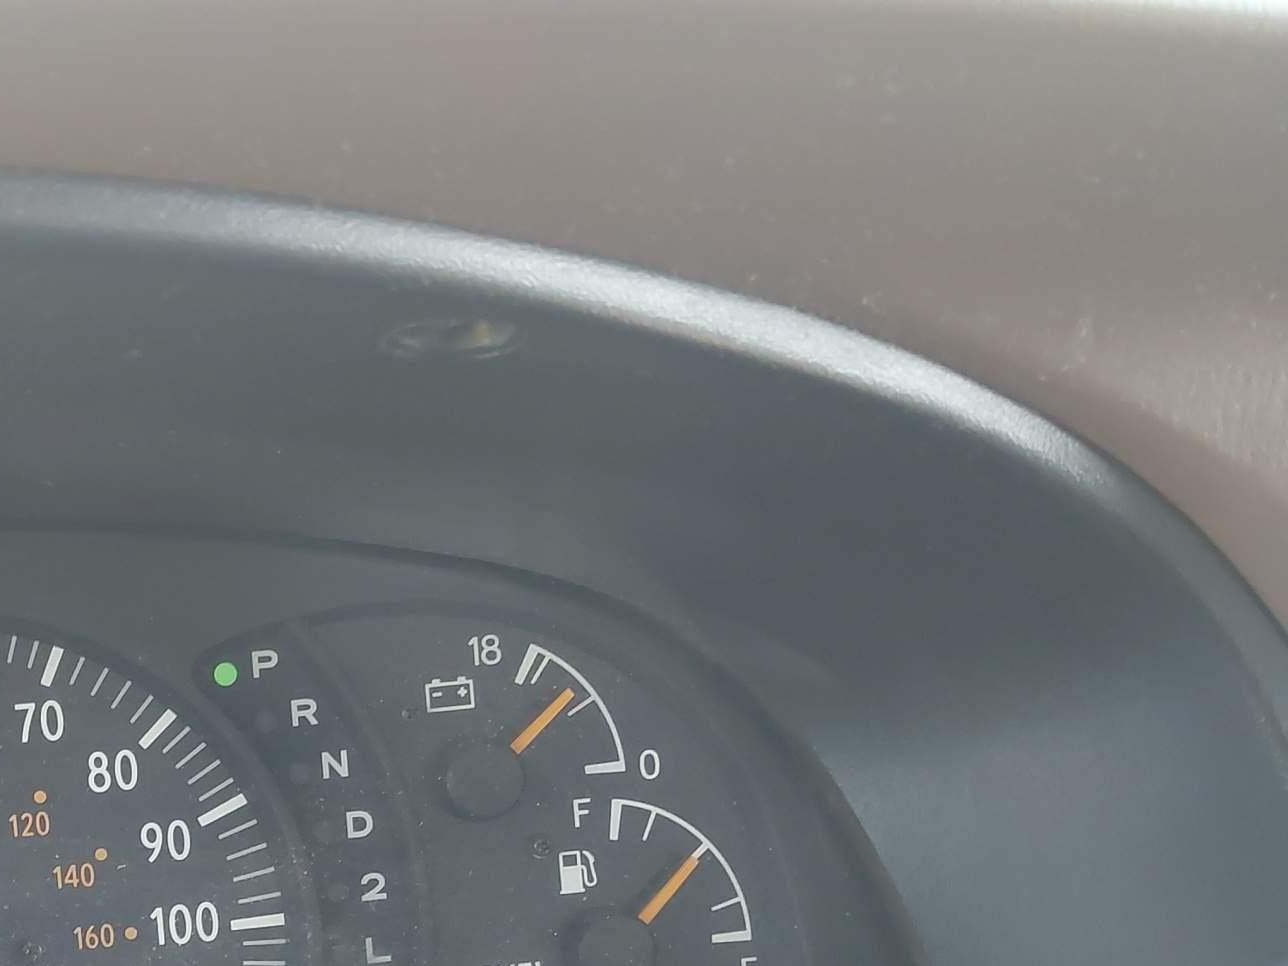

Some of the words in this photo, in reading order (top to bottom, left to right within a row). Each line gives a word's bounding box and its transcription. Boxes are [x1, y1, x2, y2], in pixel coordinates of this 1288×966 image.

[251, 649, 279, 679] P
[467, 634, 502, 666] 18
[14, 699, 64, 743] 70
[290, 698, 319, 727] R
[88, 749, 138, 793] 80
[321, 749, 349, 780] N
[9, 811, 50, 838] 120
[345, 810, 374, 839] D
[573, 797, 591, 828] F
[140, 819, 191, 863] 90
[52, 862, 95, 889] 140
[360, 872, 388, 902] 2
[73, 923, 115, 950] 160
[149, 901, 219, 946] 100
[365, 936, 392, 964] L
